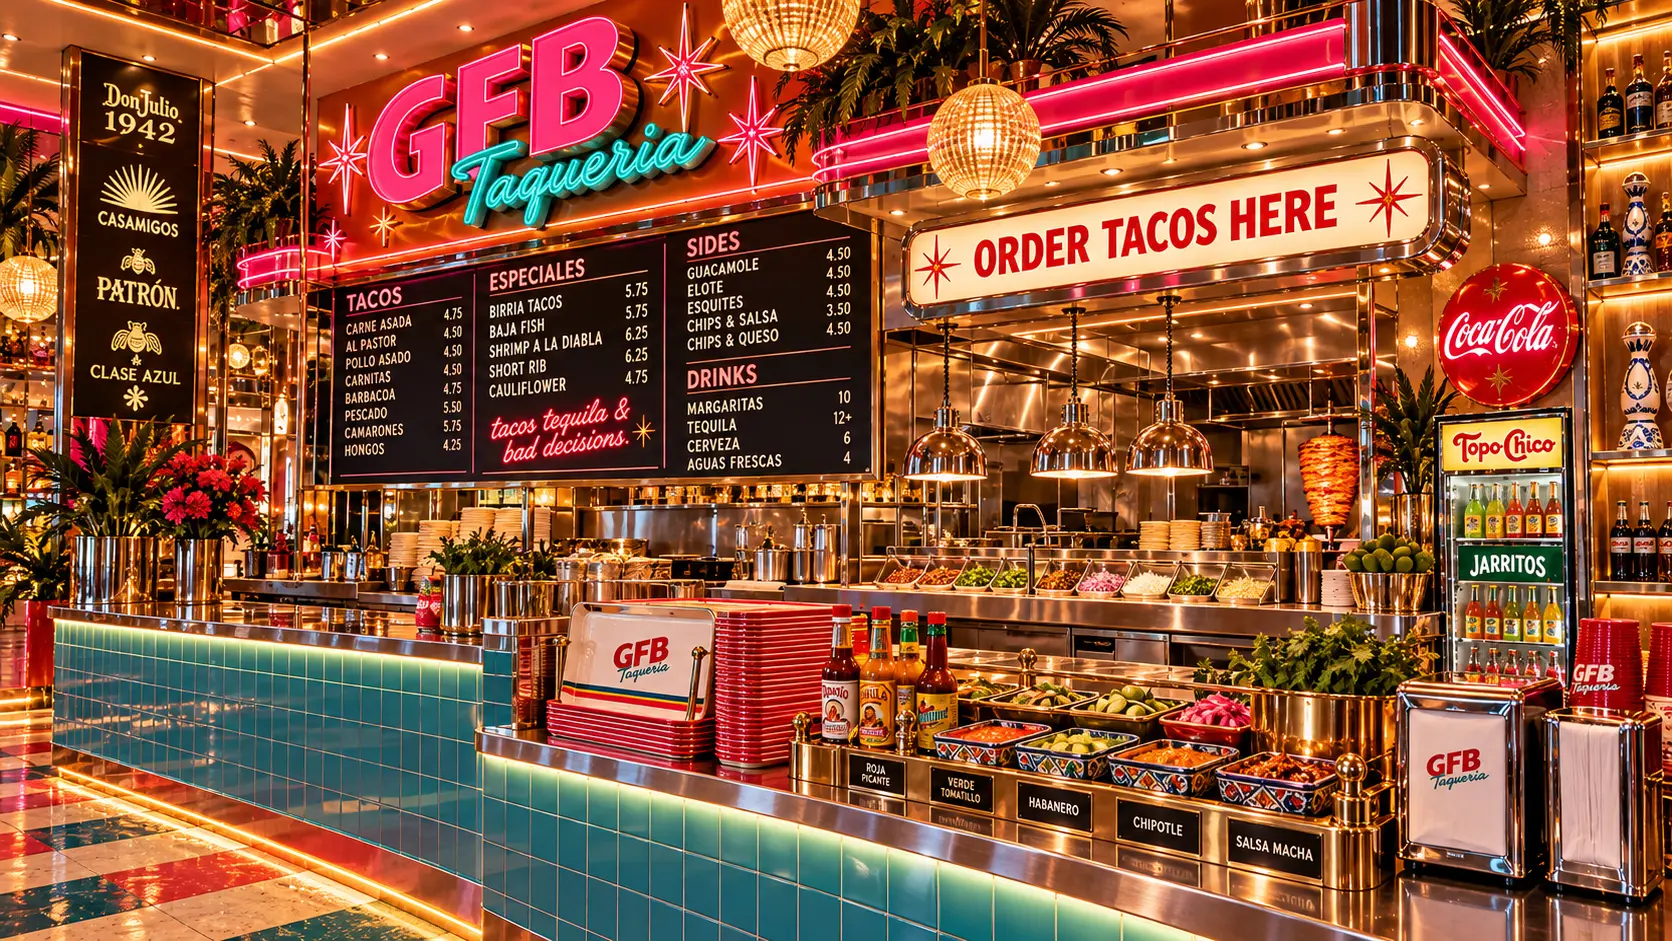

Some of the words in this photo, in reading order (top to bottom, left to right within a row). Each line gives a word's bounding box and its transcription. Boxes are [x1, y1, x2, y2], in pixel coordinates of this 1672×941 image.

[367, 16, 626, 204] GFB
[105, 111, 176, 144] 1942
[451, 122, 713, 228] Taqueria
[98, 211, 178, 237] CASAMIGOS
[973, 224, 1091, 278] ORDER
[1102, 203, 1217, 259] TACOS
[1230, 184, 1338, 241] HERE
[687, 231, 740, 257] SIDES
[490, 258, 585, 292] ESPECIALES
[686, 257, 760, 281] GUACAMOLE
[826, 246, 851, 262] 4.50
[687, 280, 724, 298] ELOTE
[826, 264, 851, 280] 4.50
[347, 286, 402, 312] TACOS
[489, 301, 525, 319] BIRRIA
[527, 294, 563, 313] TACOS
[625, 281, 648, 298] 5.75
[686, 295, 744, 316] ESQUITES
[826, 282, 851, 298] 4.50
[345, 319, 377, 336] CARNE
[379, 314, 412, 331] ASADA
[443, 306, 463, 321] 4.75
[489, 321, 517, 339] BAJA
[520, 317, 545, 335] FISH
[625, 303, 648, 320] 5.75
[686, 315, 722, 334] CHIPS
[726, 315, 734, 327] &
[738, 308, 779, 327] SALSA
[826, 301, 851, 317] 3.50
[1444, 300, 1559, 360] Coca-Cola
[345, 340, 358, 353] AL
[360, 334, 397, 351] PASTOR
[443, 325, 463, 339] 4.50
[488, 340, 530, 359] SHRIMP
[532, 338, 541, 353] A
[544, 336, 559, 352] LA
[561, 330, 603, 348] DIABLA
[625, 324, 648, 342] 6.25
[687, 334, 722, 352] CHIPS
[726, 334, 734, 346] &
[738, 328, 779, 347] QUESO
[826, 320, 851, 336] 4.50
[345, 354, 376, 370] POLLO
[378, 350, 411, 366] ASADO
[443, 343, 463, 358] 4.50
[488, 361, 525, 379] SHORT
[528, 358, 547, 374] RIB
[625, 346, 648, 363] 6.25
[89, 363, 138, 382] CLASE
[141, 369, 181, 385] AZUL
[345, 370, 391, 388] CARNITAS
[443, 362, 462, 376] 4.50
[488, 376, 567, 399] CAULIFLOWER
[624, 369, 648, 385] 4.75
[687, 364, 757, 390] DRINKS
[345, 387, 396, 405] BARBACOA
[443, 381, 462, 395] 4.75
[687, 396, 764, 416] MARGARITAS
[838, 389, 851, 404] 10
[344, 406, 388, 422] PESCADO
[443, 400, 462, 414] 5.50
[490, 416, 538, 440] tacos
[543, 398, 608, 436] tequila
[614, 397, 630, 420] &
[686, 417, 738, 435] TEQUILA
[833, 410, 852, 425] 12+
[344, 422, 404, 439] CAMARONES
[443, 419, 462, 433] 5.75
[687, 436, 741, 453] CERVEZA
[843, 430, 851, 445] 6
[344, 442, 385, 457] HONGOS
[442, 438, 462, 451] 4.25
[503, 435, 540, 463] bad
[542, 429, 629, 457] decisions.
[686, 456, 726, 471] AGUAS
[730, 453, 783, 470] FRESCAS
[843, 450, 851, 465] 4
[1469, 554, 1547, 578] JARRITOS
[614, 636, 669, 668] GFB
[617, 662, 670, 683] Taqueria
[1572, 662, 1616, 683] GFB
[865, 761, 887, 777] ROJA
[1426, 748, 1481, 777] GFB
[860, 773, 891, 788] PICANTE
[947, 776, 976, 792] VERDE
[1430, 770, 1489, 790] Taqueria
[939, 786, 982, 804] TOMATILLO
[1028, 796, 1080, 816] HABANERO
[1133, 815, 1183, 837] CHIPOTLE
[1236, 835, 1270, 853] SALSA
[1272, 841, 1314, 862] MACHA
